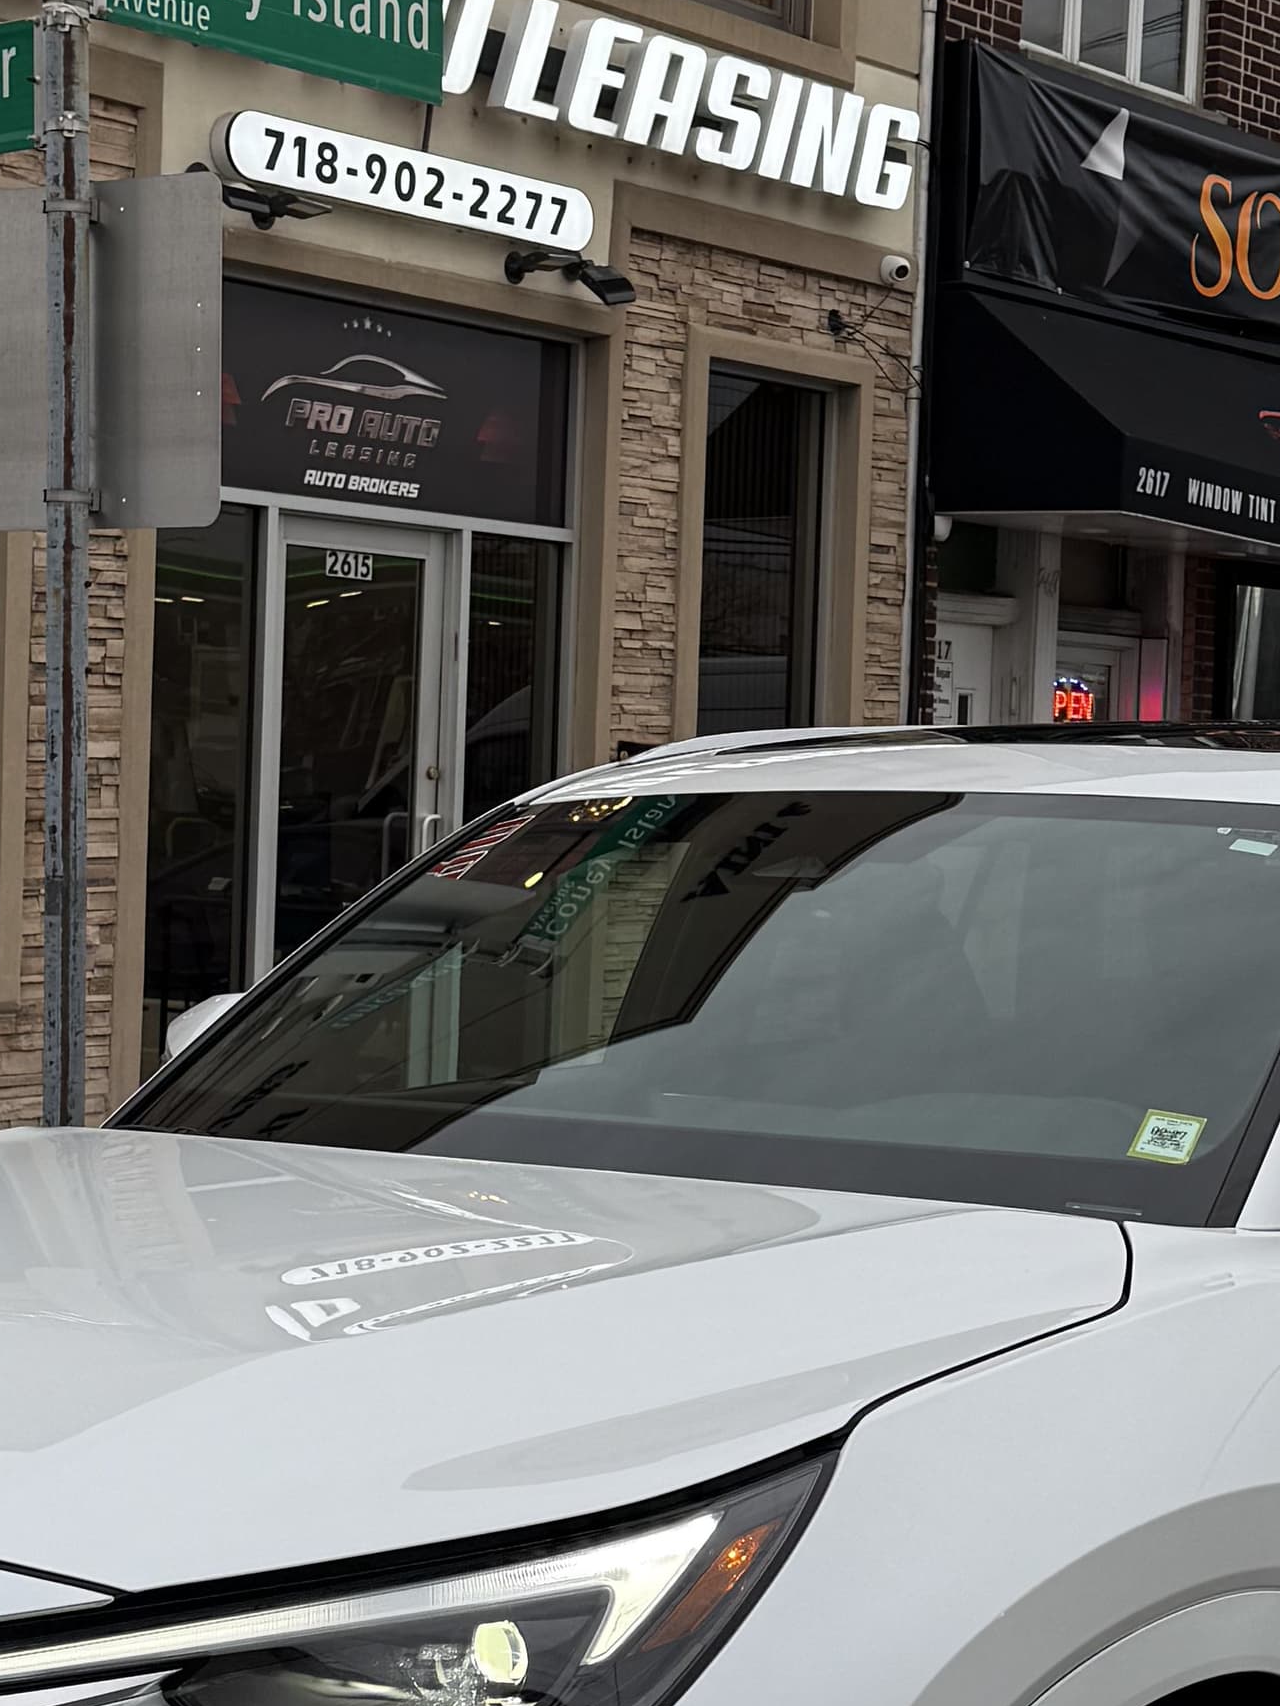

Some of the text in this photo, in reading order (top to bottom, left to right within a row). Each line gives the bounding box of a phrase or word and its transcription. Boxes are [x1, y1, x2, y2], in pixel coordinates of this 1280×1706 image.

[263, 128, 567, 236] 718-902-2277
[285, 398, 442, 448] PRO AUTO
[309, 439, 417, 469] LEASING
[304, 469, 420, 498] AUTO BROKERS
[1136, 467, 1170, 498] 2617
[1187, 478, 1243, 516] WINDOW
[1248, 494, 1276, 524] TINT
[327, 551, 371, 578] 2615
[1054, 690, 1094, 722] PEN
